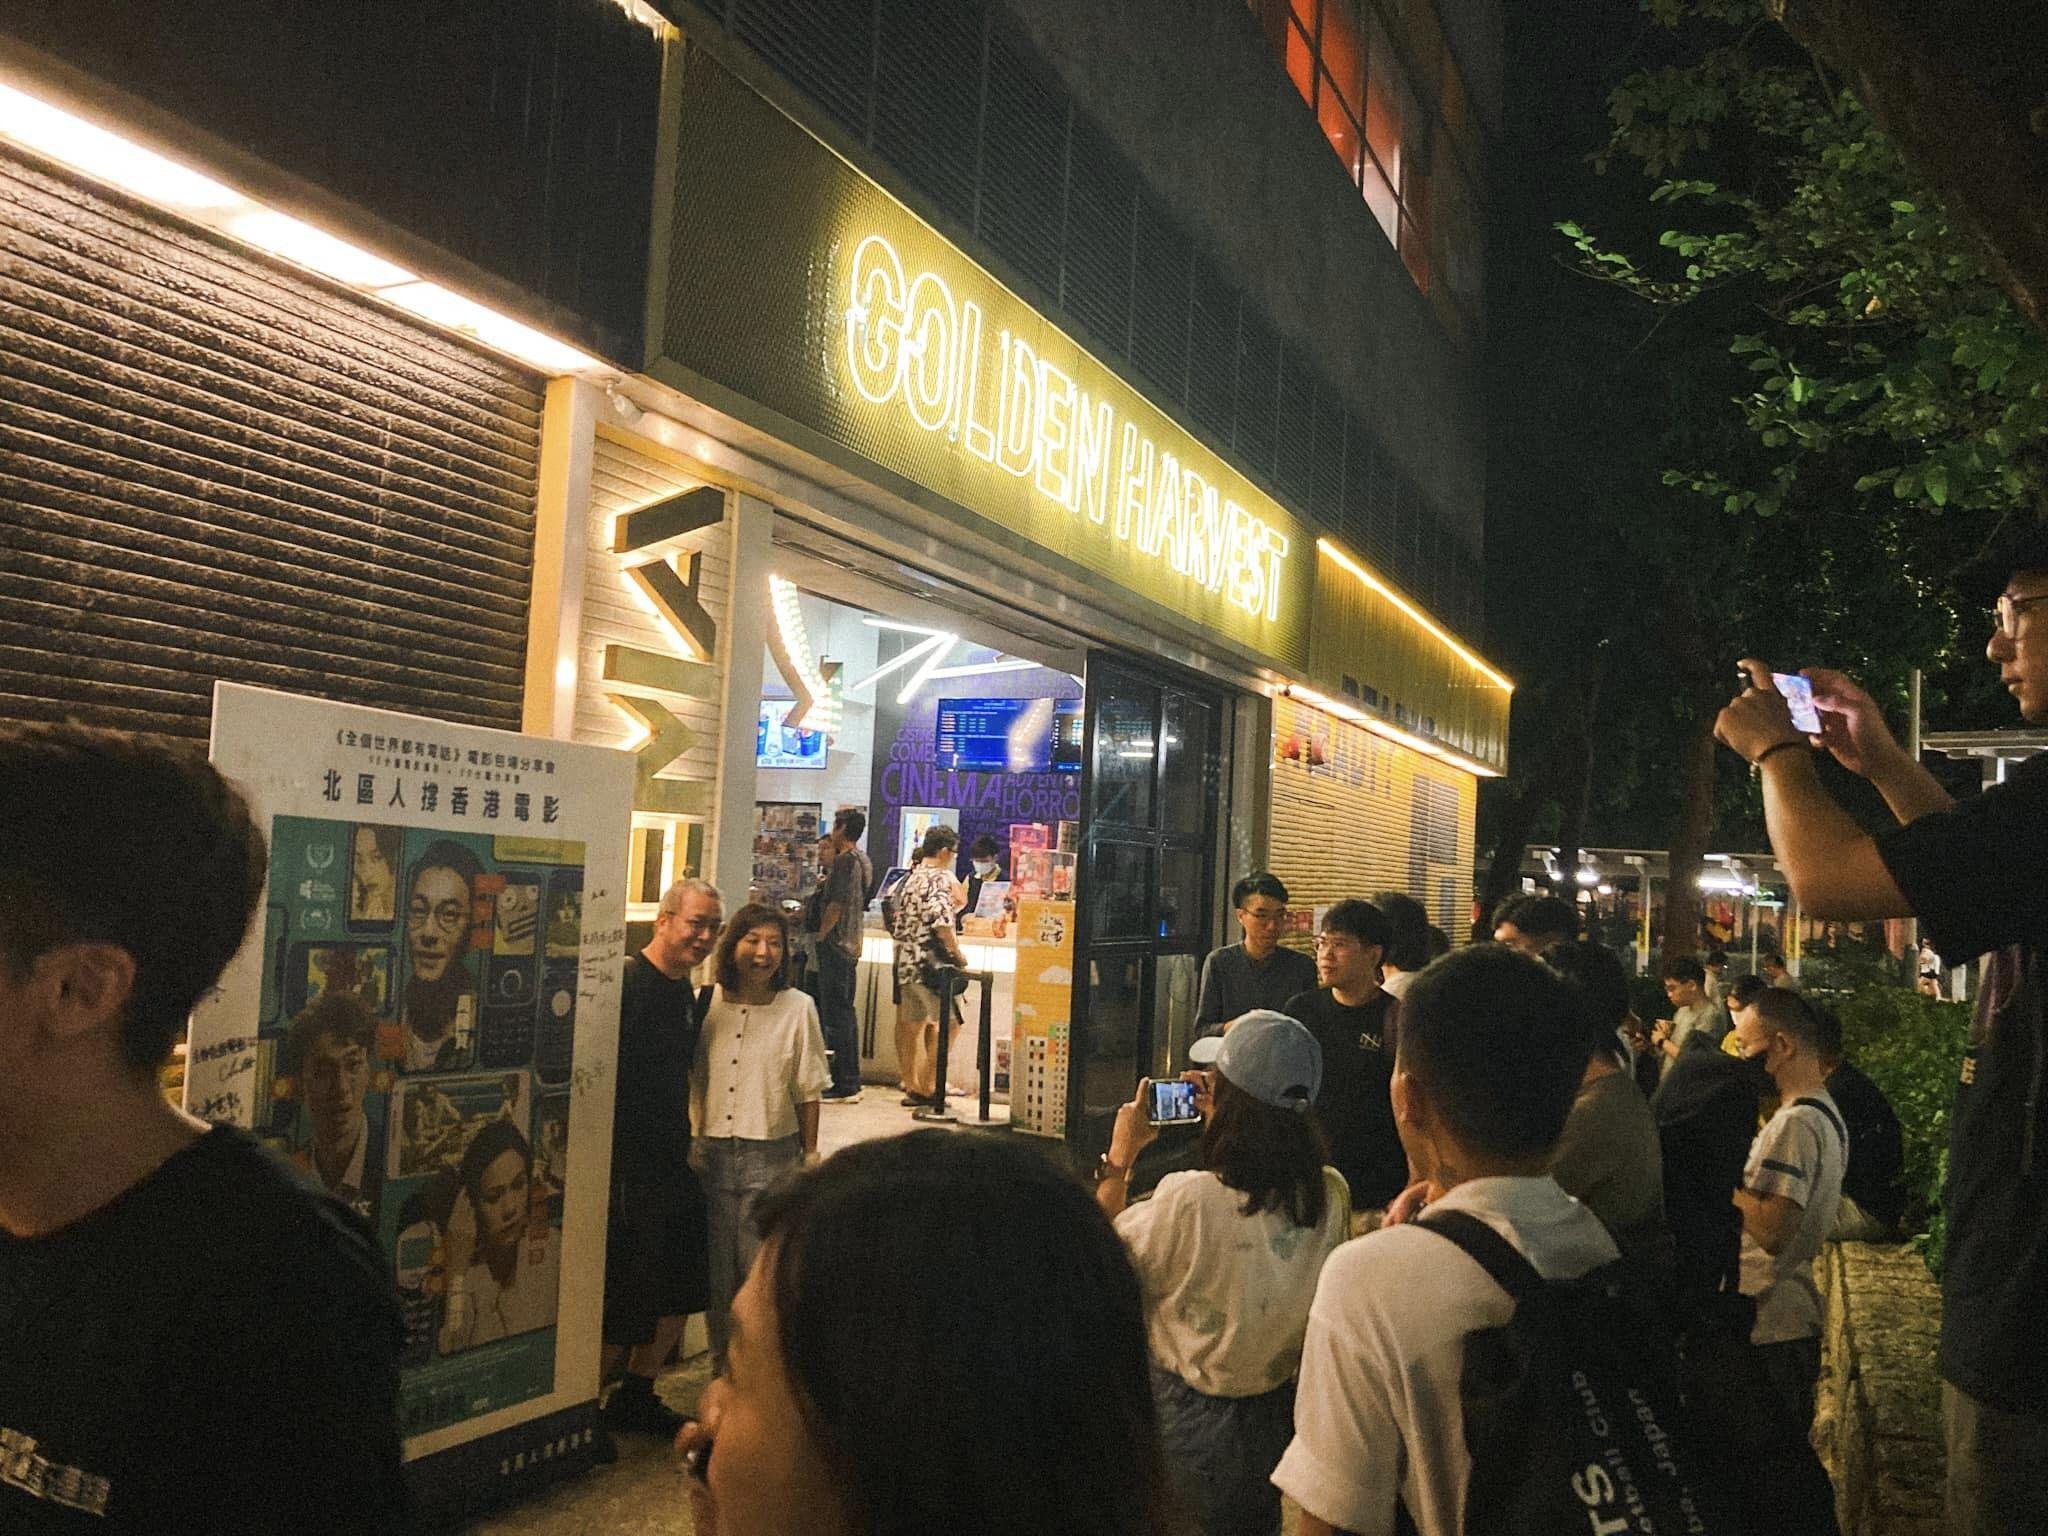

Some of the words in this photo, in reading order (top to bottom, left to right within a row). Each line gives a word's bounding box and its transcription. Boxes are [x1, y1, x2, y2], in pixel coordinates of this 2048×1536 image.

[845, 234, 1113, 526] GOLDEN
[1115, 421, 1290, 623] HARVEST
[322, 768, 560, 824] 北區人撐香港電影
[881, 763, 1002, 807] CINEMA
